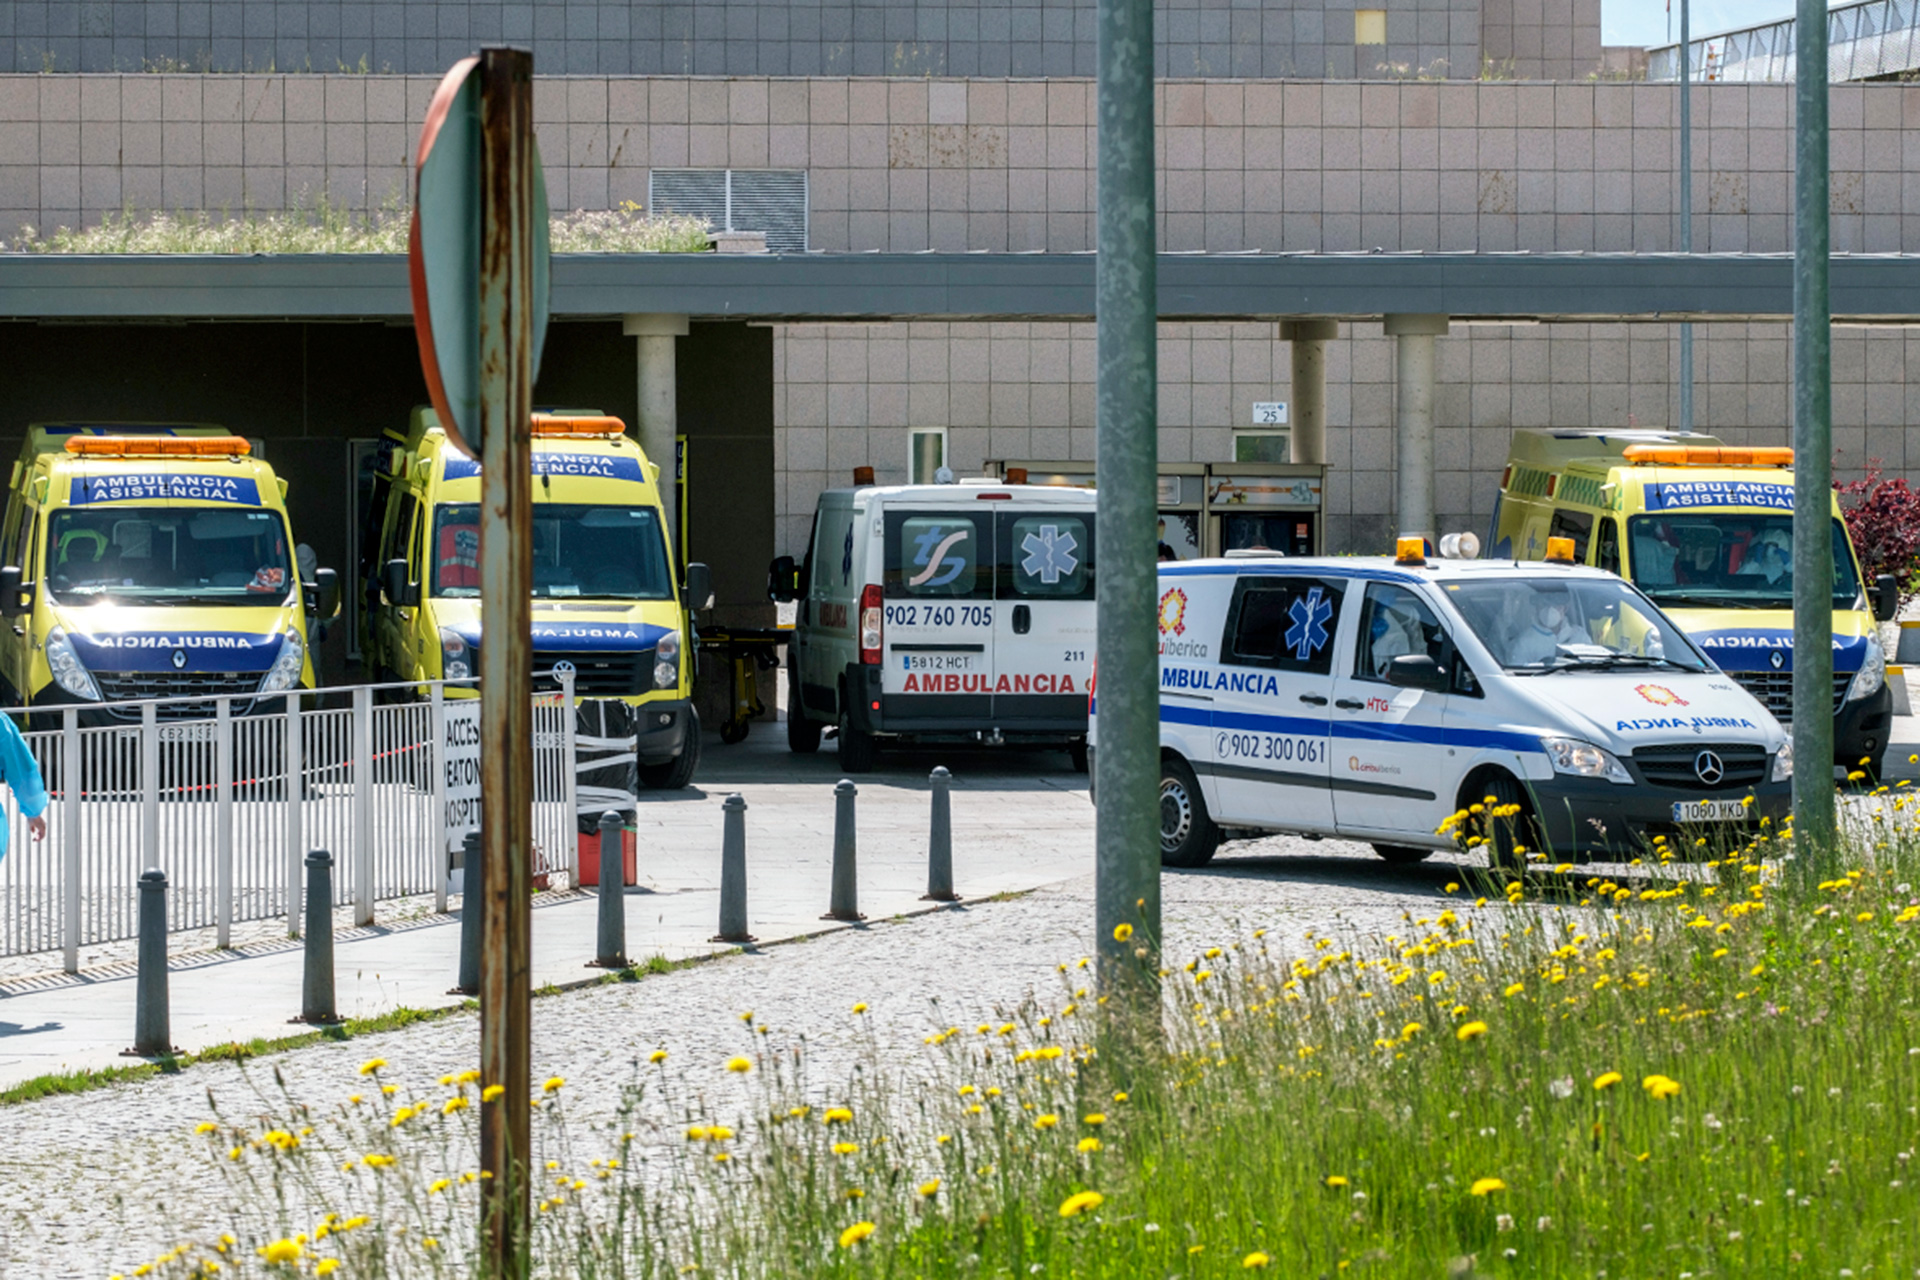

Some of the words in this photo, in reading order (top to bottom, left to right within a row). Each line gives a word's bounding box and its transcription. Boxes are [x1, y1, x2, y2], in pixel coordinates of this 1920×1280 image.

[1263, 411, 1278, 422] 25
[535, 454, 614, 466] LANCIA
[93, 475, 238, 490] AMBULANCIA
[1663, 482, 1795, 496] AMBULANCIA
[93, 485, 239, 501] ASISTENCIAL
[885, 605, 917, 626] 902
[923, 606, 955, 627] 760
[960, 606, 993, 627] 705
[911, 655, 943, 669] 5812
[946, 656, 971, 669] HCT
[1064, 650, 1085, 662] 211
[903, 673, 1076, 693] AMBULANCIA
[1161, 667, 1279, 696] MBULANCIA
[1366, 696, 1389, 713] HTG
[1231, 734, 1260, 758] 902
[1264, 736, 1293, 760] 300
[1297, 739, 1325, 763] 061
[1685, 803, 1716, 819] 1060
[1719, 802, 1744, 818] HKD
